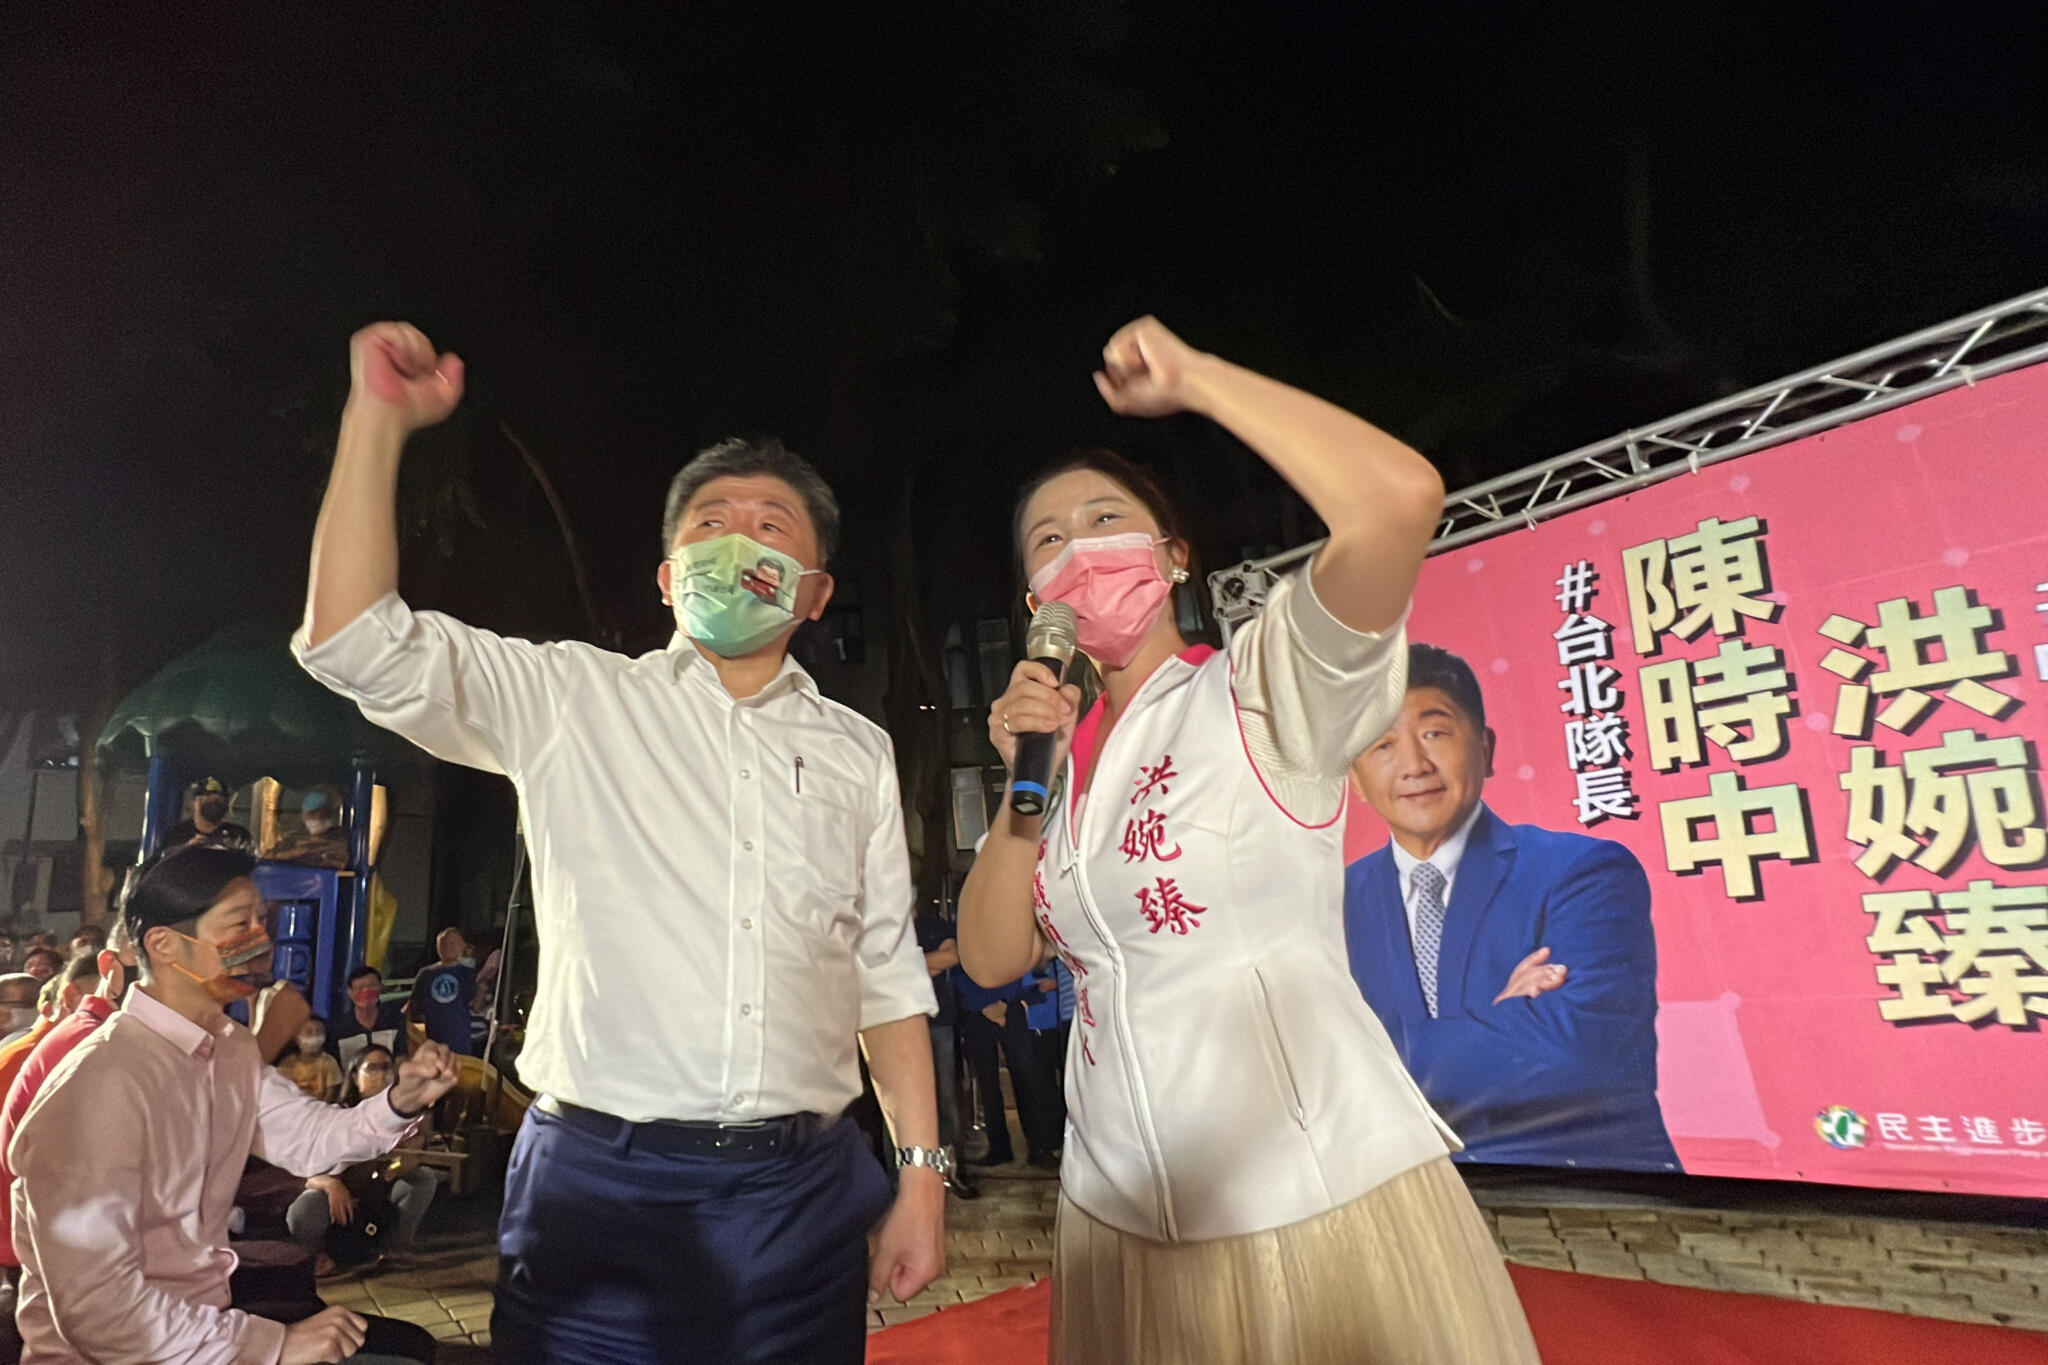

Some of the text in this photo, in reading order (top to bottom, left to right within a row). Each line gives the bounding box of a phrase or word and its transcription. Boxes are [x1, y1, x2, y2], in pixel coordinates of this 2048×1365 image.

[1553, 559, 1637, 824] #台北隊長
[1622, 516, 1814, 900] 陳時中
[1817, 585, 2048, 1028] 洪婉臻
[1118, 755, 1208, 935] 洪婉臻
[1876, 1113, 2047, 1145] 民主進步
